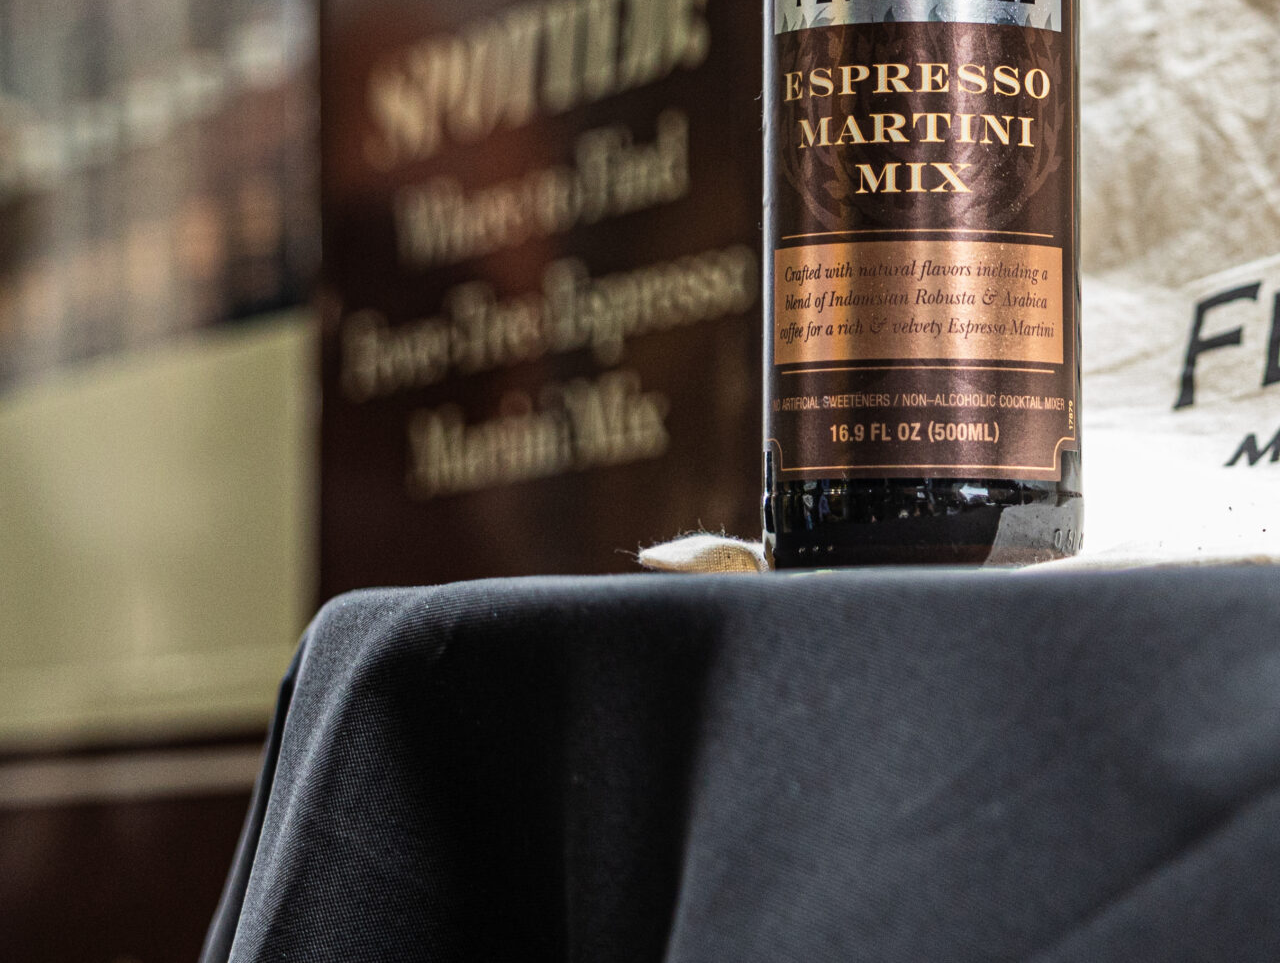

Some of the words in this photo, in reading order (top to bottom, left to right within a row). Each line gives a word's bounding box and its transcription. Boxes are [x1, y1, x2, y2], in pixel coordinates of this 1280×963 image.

[783, 63, 1051, 102] ESPRESSO
[798, 113, 1036, 149] MARTINI
[855, 163, 973, 194] MIX
[785, 263, 822, 286] Crafted
[825, 262, 853, 279] with
[859, 260, 916, 277] natural
[916, 260, 972, 282] flavors
[976, 261, 1040, 285] including
[1041, 269, 1049, 281] a
[785, 292, 812, 311] blend
[814, 291, 828, 314] of
[915, 288, 976, 306] Robusta
[982, 288, 998, 306] &
[1001, 290, 1048, 309] Arabica
[779, 322, 804, 345] coffee
[804, 321, 823, 343] for
[825, 324, 834, 337] a
[837, 318, 863, 336] rich
[892, 317, 943, 339] velvety
[948, 317, 1006, 340] Espresso
[1010, 317, 1055, 338] Martini
[782, 395, 821, 411] ARTIFICIAL
[822, 393, 891, 409] SWEETENERS
[901, 392, 996, 408] NON-ALCOHOLIC
[999, 394, 1043, 410] COCKTAIL
[1044, 396, 1065, 411] MIXER
[829, 423, 865, 443] 16.9
[871, 423, 892, 442] FL
[897, 422, 921, 442] OZ
[927, 420, 1000, 444] (500ML)
